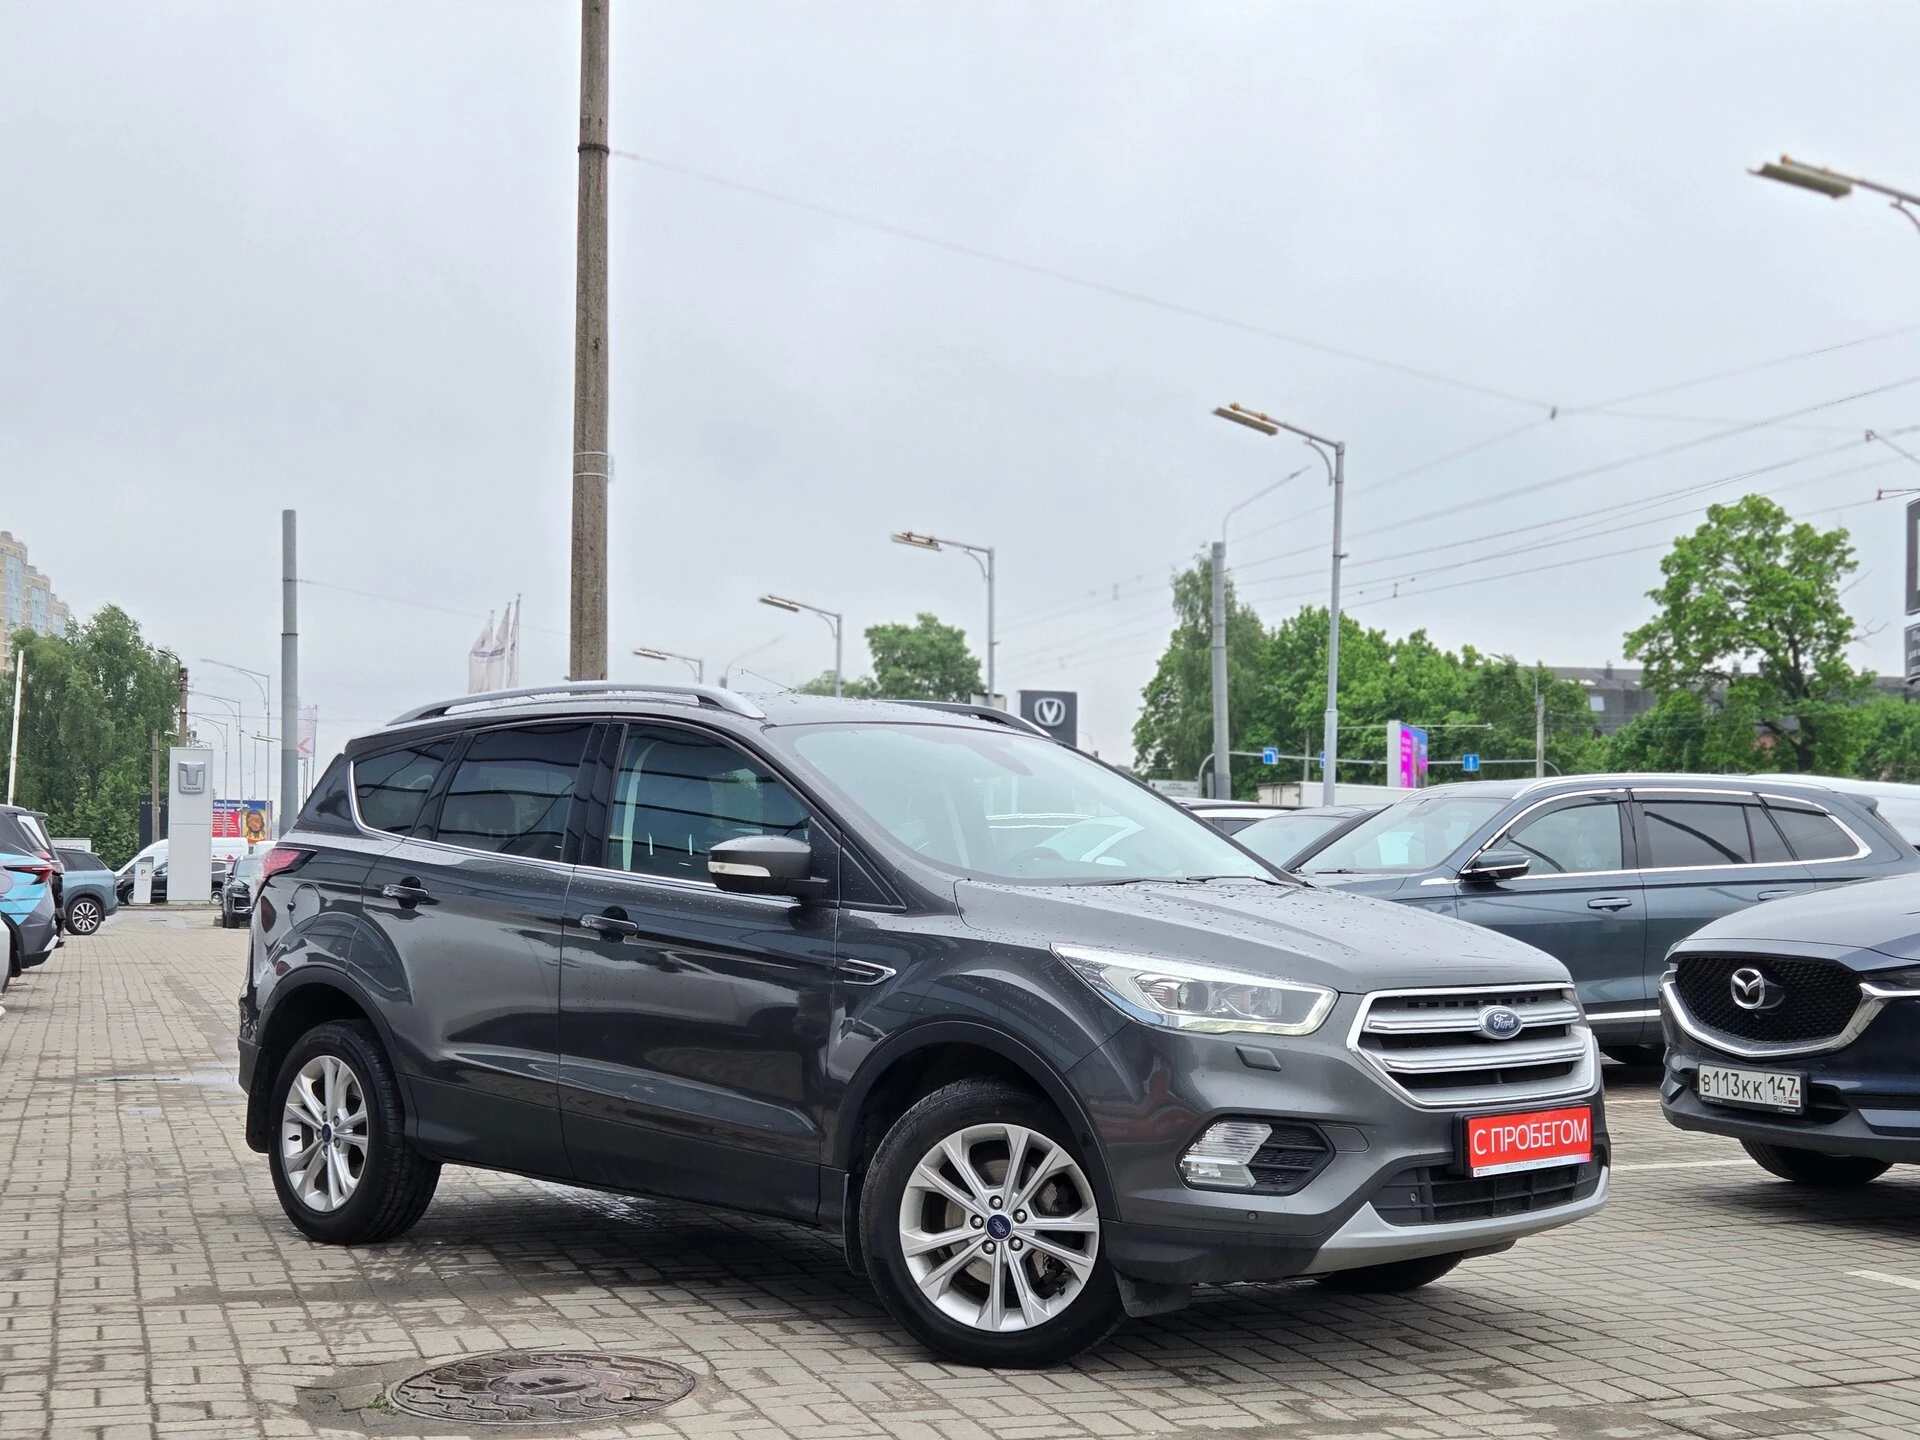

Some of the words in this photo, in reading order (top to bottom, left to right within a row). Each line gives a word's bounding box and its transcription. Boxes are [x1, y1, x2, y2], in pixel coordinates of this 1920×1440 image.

[1494, 1013, 1515, 1030] Ford
[1767, 1075, 1797, 1097] 147
[1773, 1095, 1788, 1105] RUS
[1473, 1128, 1488, 1155] С
[1490, 1117, 1588, 1153] ПРОБЕГОМ
